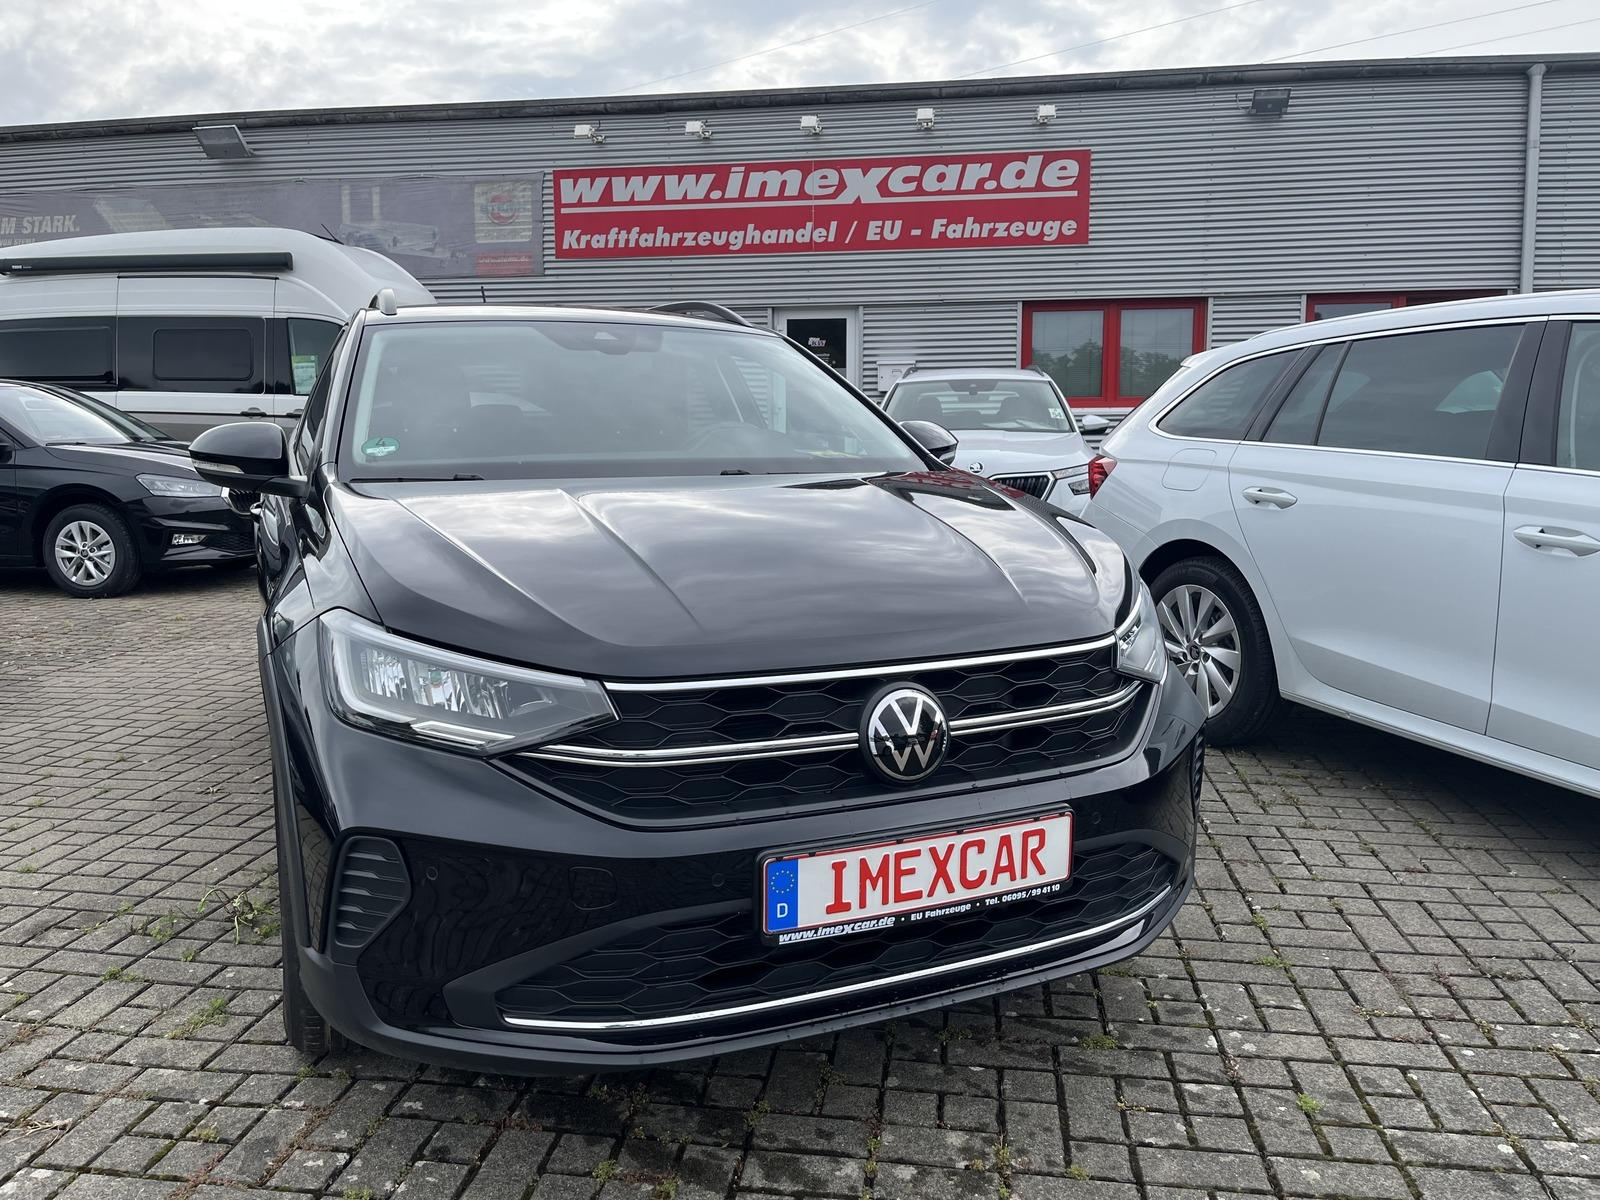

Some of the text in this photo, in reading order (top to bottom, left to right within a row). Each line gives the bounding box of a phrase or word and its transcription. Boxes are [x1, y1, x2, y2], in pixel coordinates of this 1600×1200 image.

[560, 155, 1080, 204] www.imexcar.de
[21, 215, 80, 234] STARK.
[562, 221, 837, 250] Kraftfahrzeughandel
[844, 220, 859, 244] /
[866, 220, 903, 241] EU
[930, 217, 1077, 242] Fahrzeuge
[376, 438, 386, 447] 4
[825, 827, 1046, 915] IMEXCAR
[777, 903, 788, 918] D
[779, 915, 895, 943] www.imexcar.de
[910, 912, 923, 921] EU
[925, 903, 971, 919] Fahrzeuge
[985, 897, 1000, 906] Tel.
